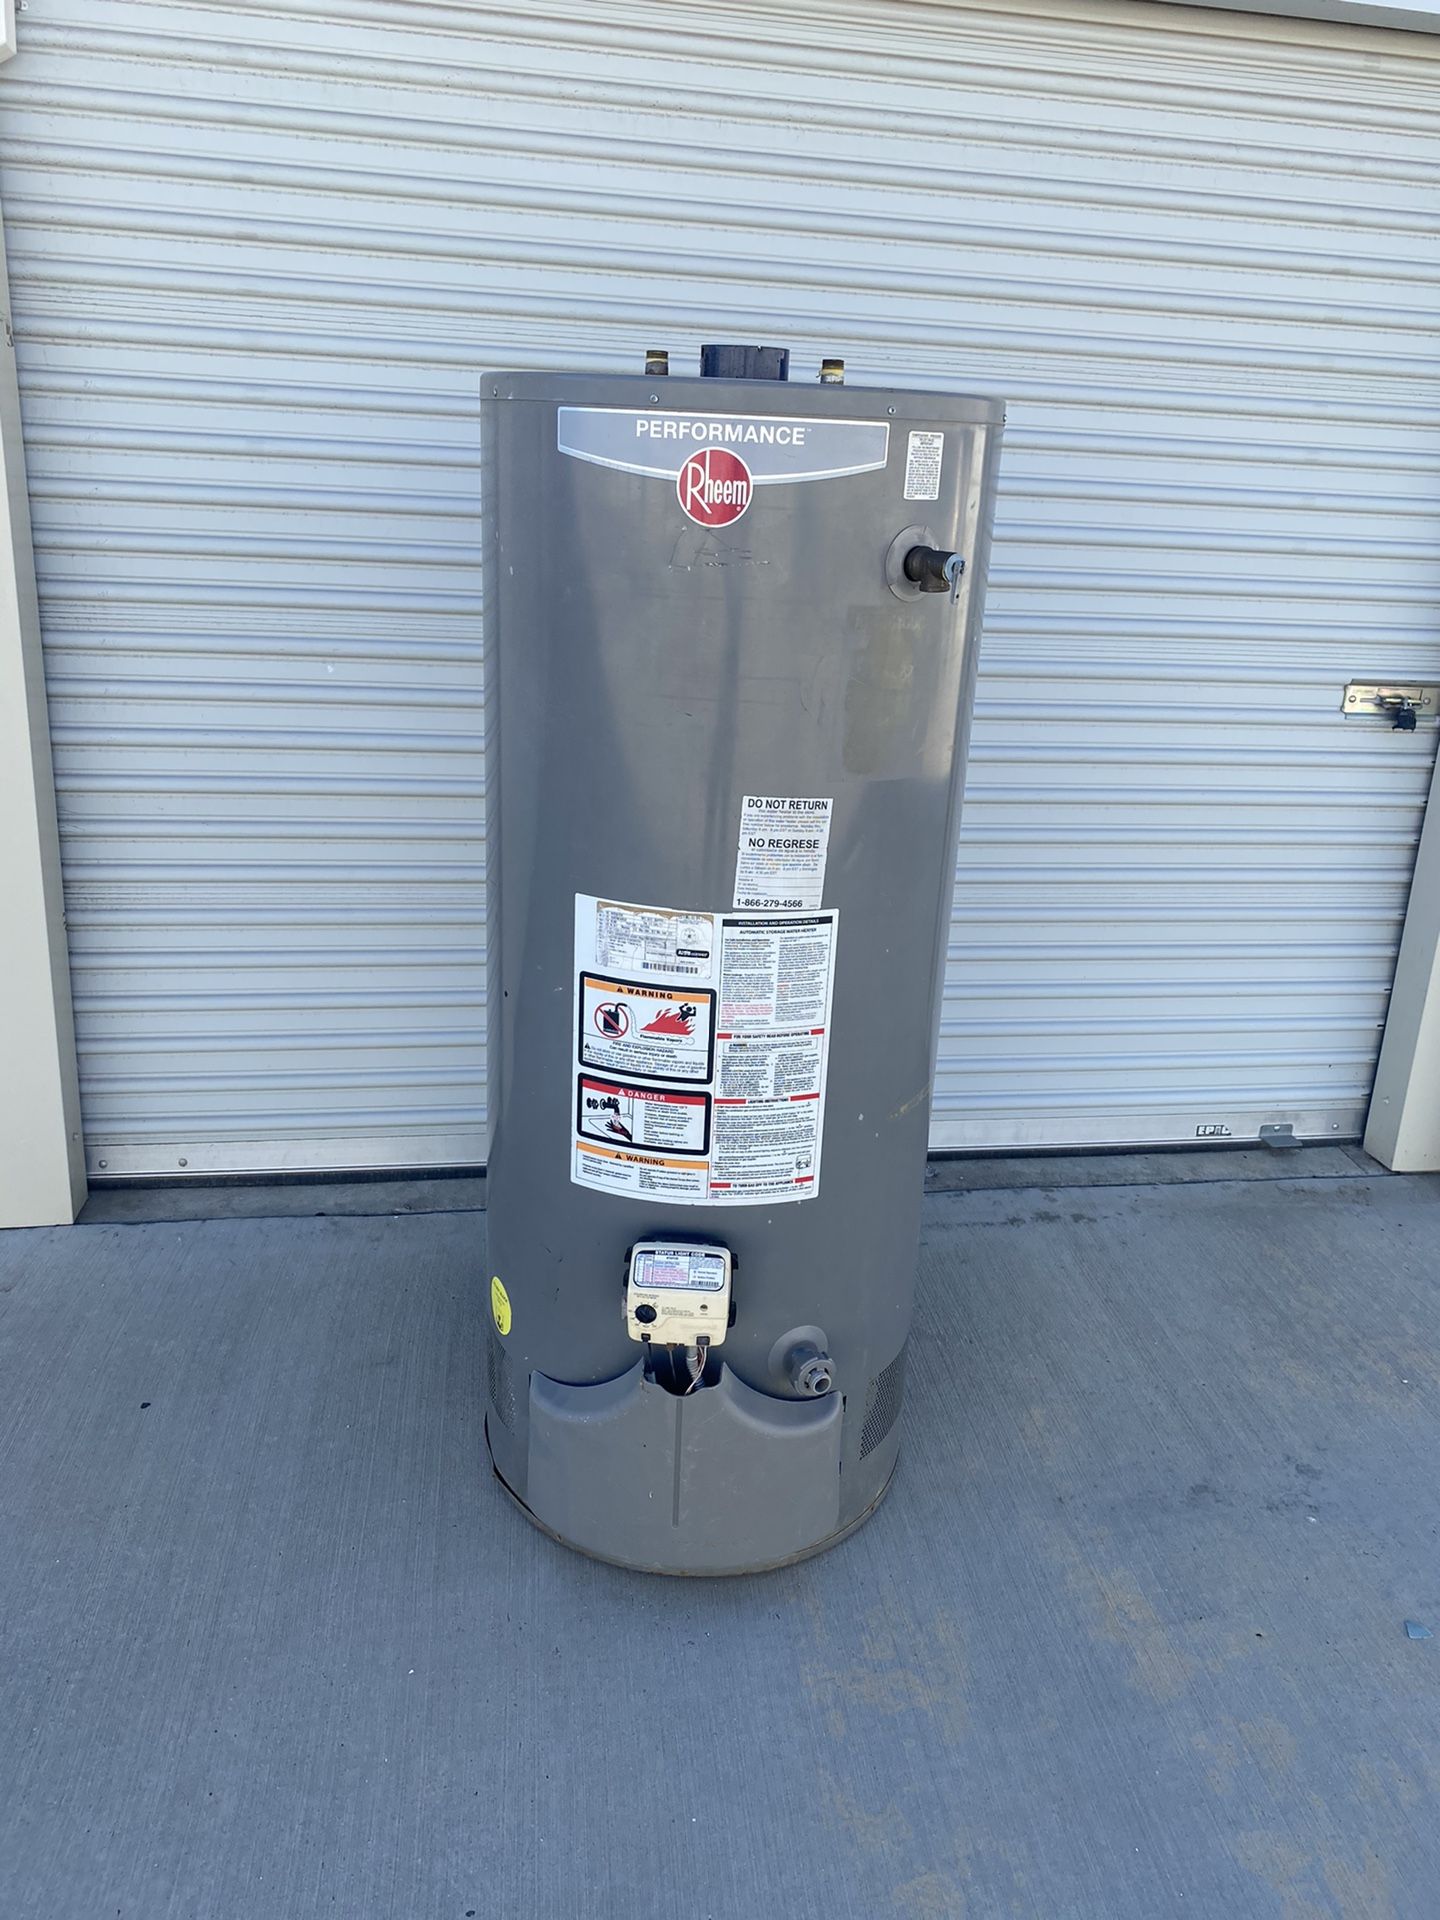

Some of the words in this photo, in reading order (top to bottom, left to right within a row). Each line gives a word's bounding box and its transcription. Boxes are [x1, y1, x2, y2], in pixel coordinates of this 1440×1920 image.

[636, 419, 805, 446] PERFORMANCE
[686, 449, 748, 515] Rheem
[747, 799, 763, 808] DO
[765, 800, 787, 810] NOT
[788, 800, 829, 810] RETURN
[748, 838, 765, 848] NO
[767, 838, 820, 849] REGRESE
[736, 898, 803, 908] 1-866-279-4566
[627, 988, 673, 1000] WARNING
[628, 1090, 666, 1101] DANGER
[626, 1155, 665, 1166] WARNING
